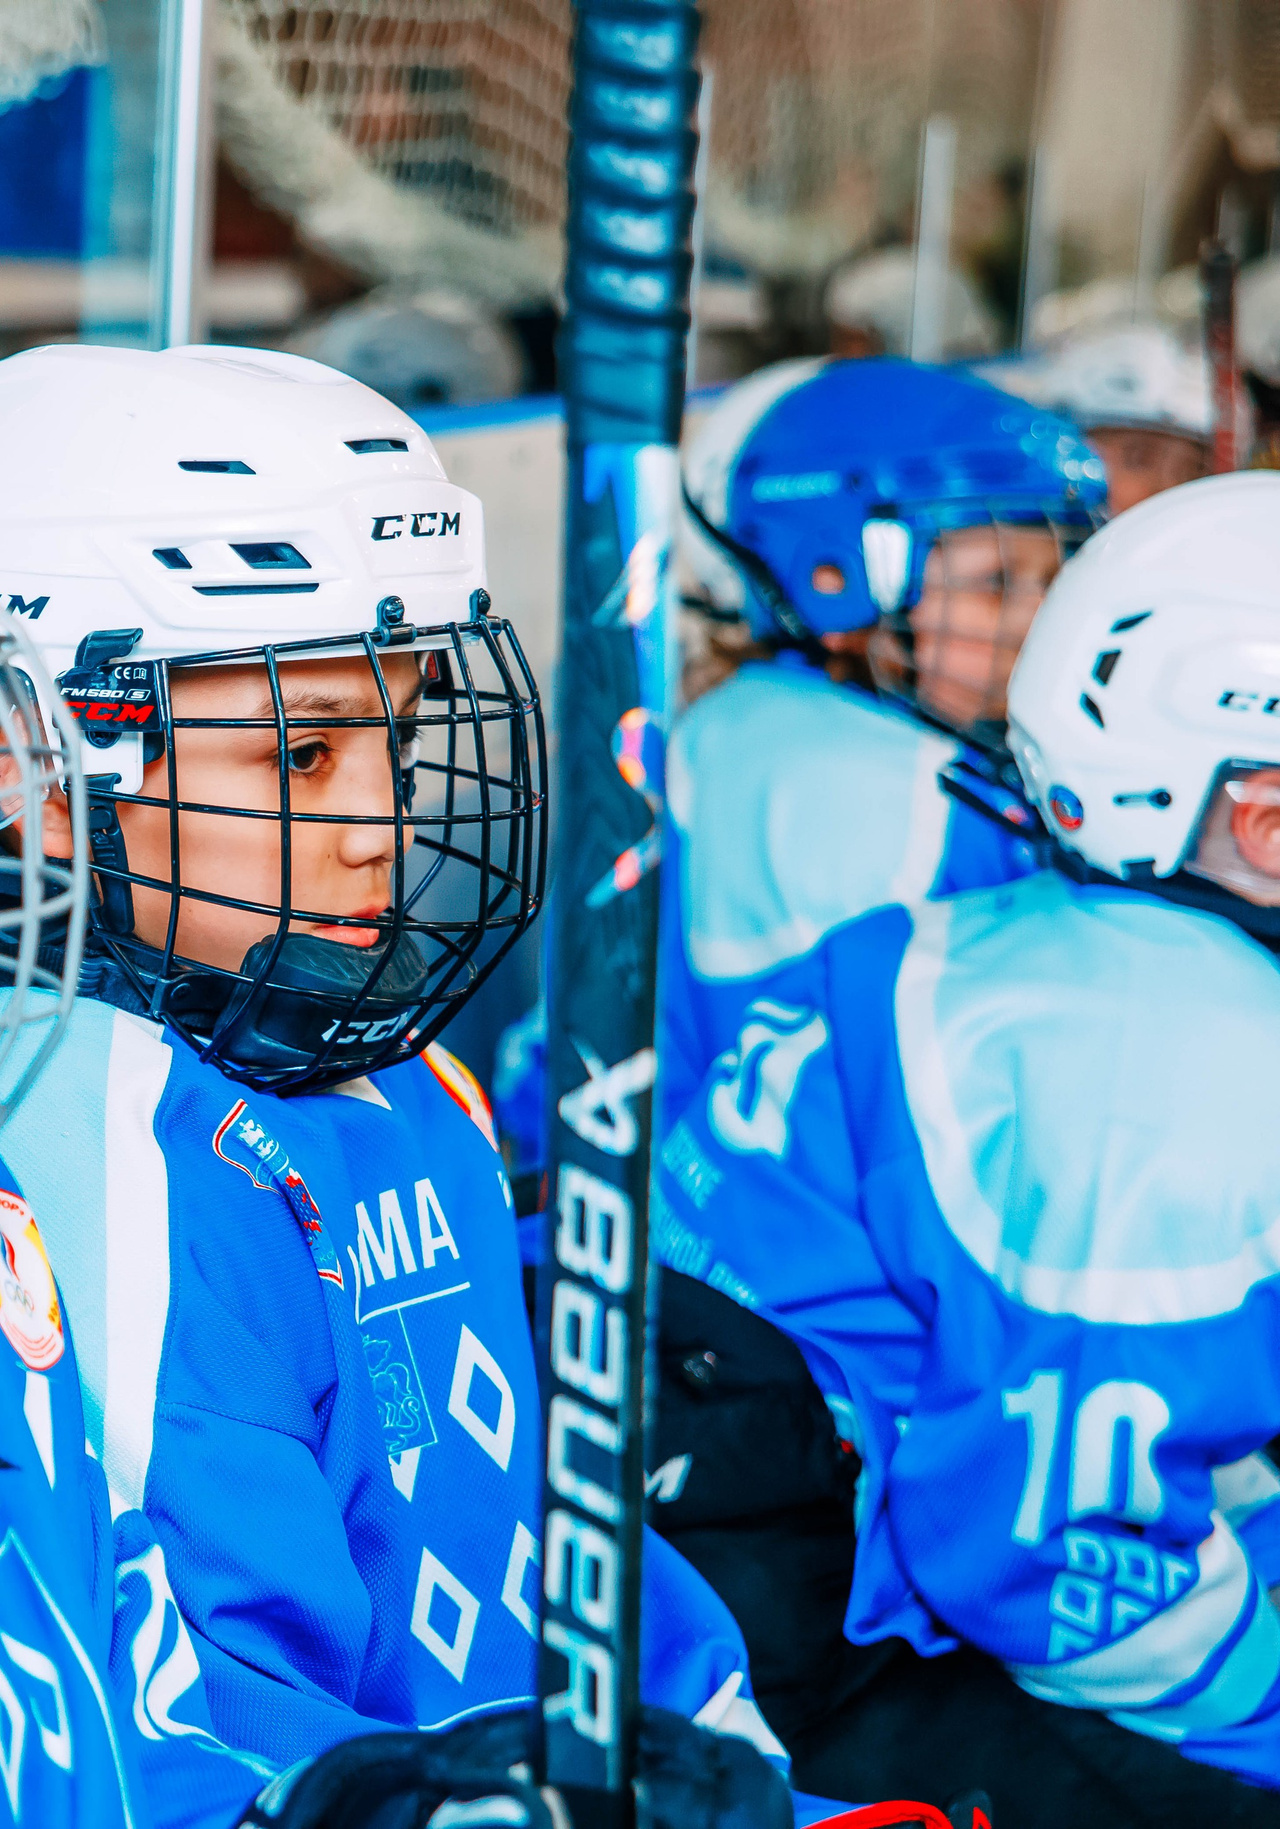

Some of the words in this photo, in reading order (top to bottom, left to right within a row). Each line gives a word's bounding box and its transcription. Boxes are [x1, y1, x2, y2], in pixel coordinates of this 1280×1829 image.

[371, 511, 461, 541] CCM
[60, 687, 125, 698] FM580
[1002, 1369, 1171, 1546] 10
